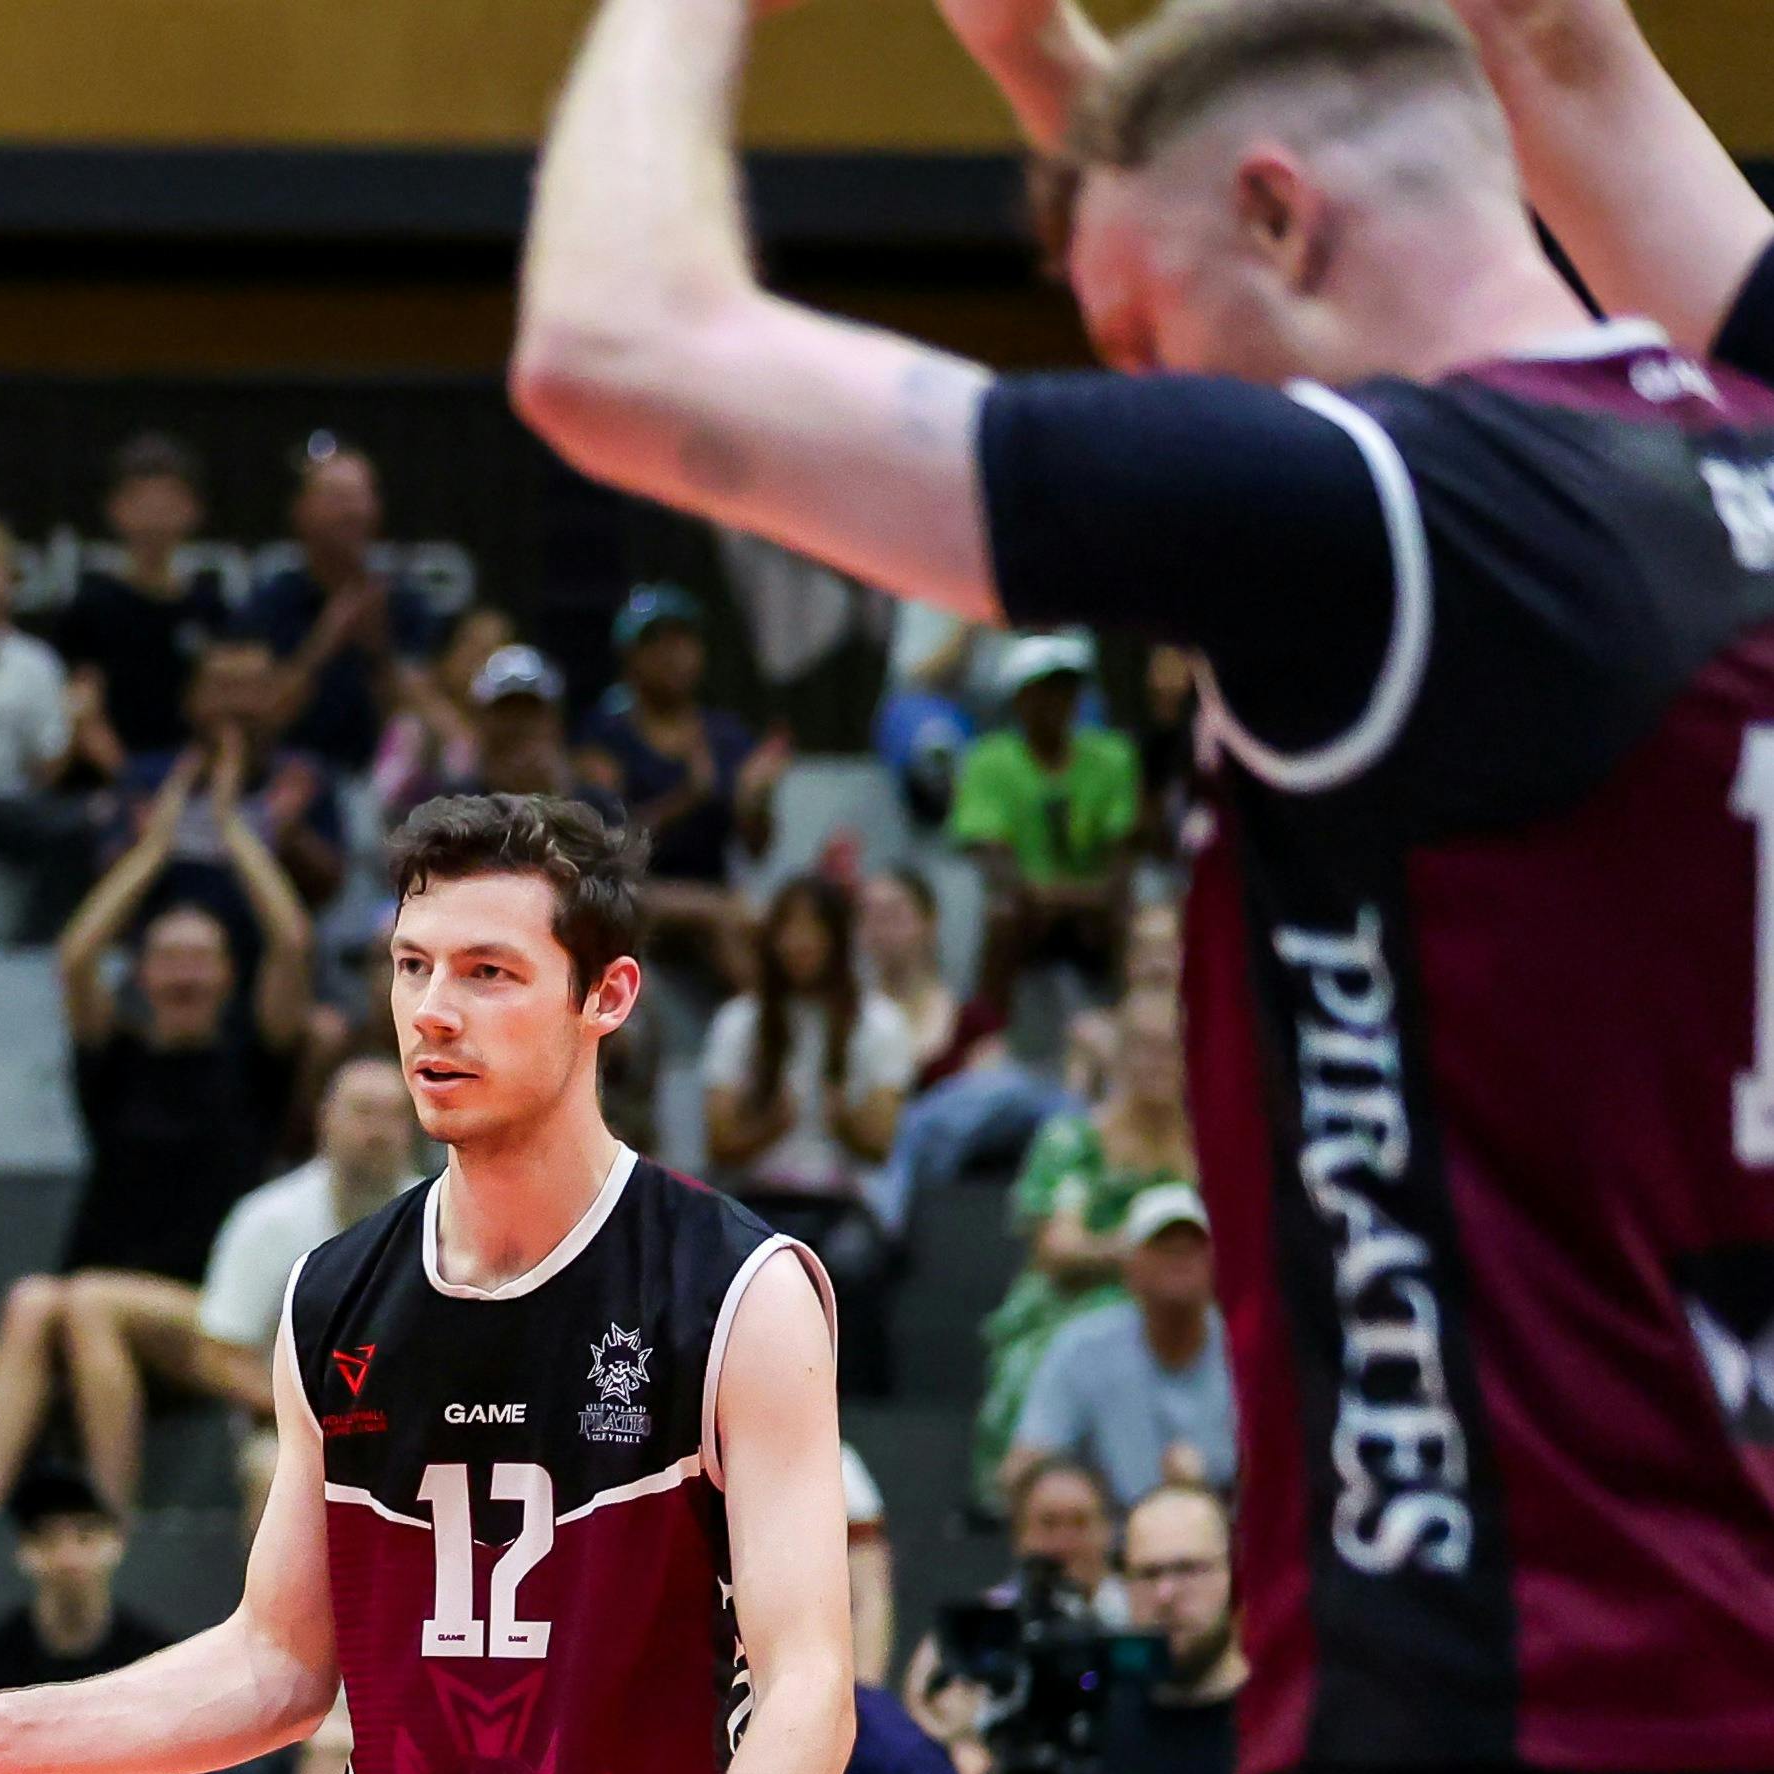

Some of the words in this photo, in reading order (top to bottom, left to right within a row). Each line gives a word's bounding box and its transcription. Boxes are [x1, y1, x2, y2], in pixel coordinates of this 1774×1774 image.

[1270, 904, 1475, 1577] PIRATES
[444, 1403, 527, 1424] GAME
[416, 1463, 554, 1658] 12
